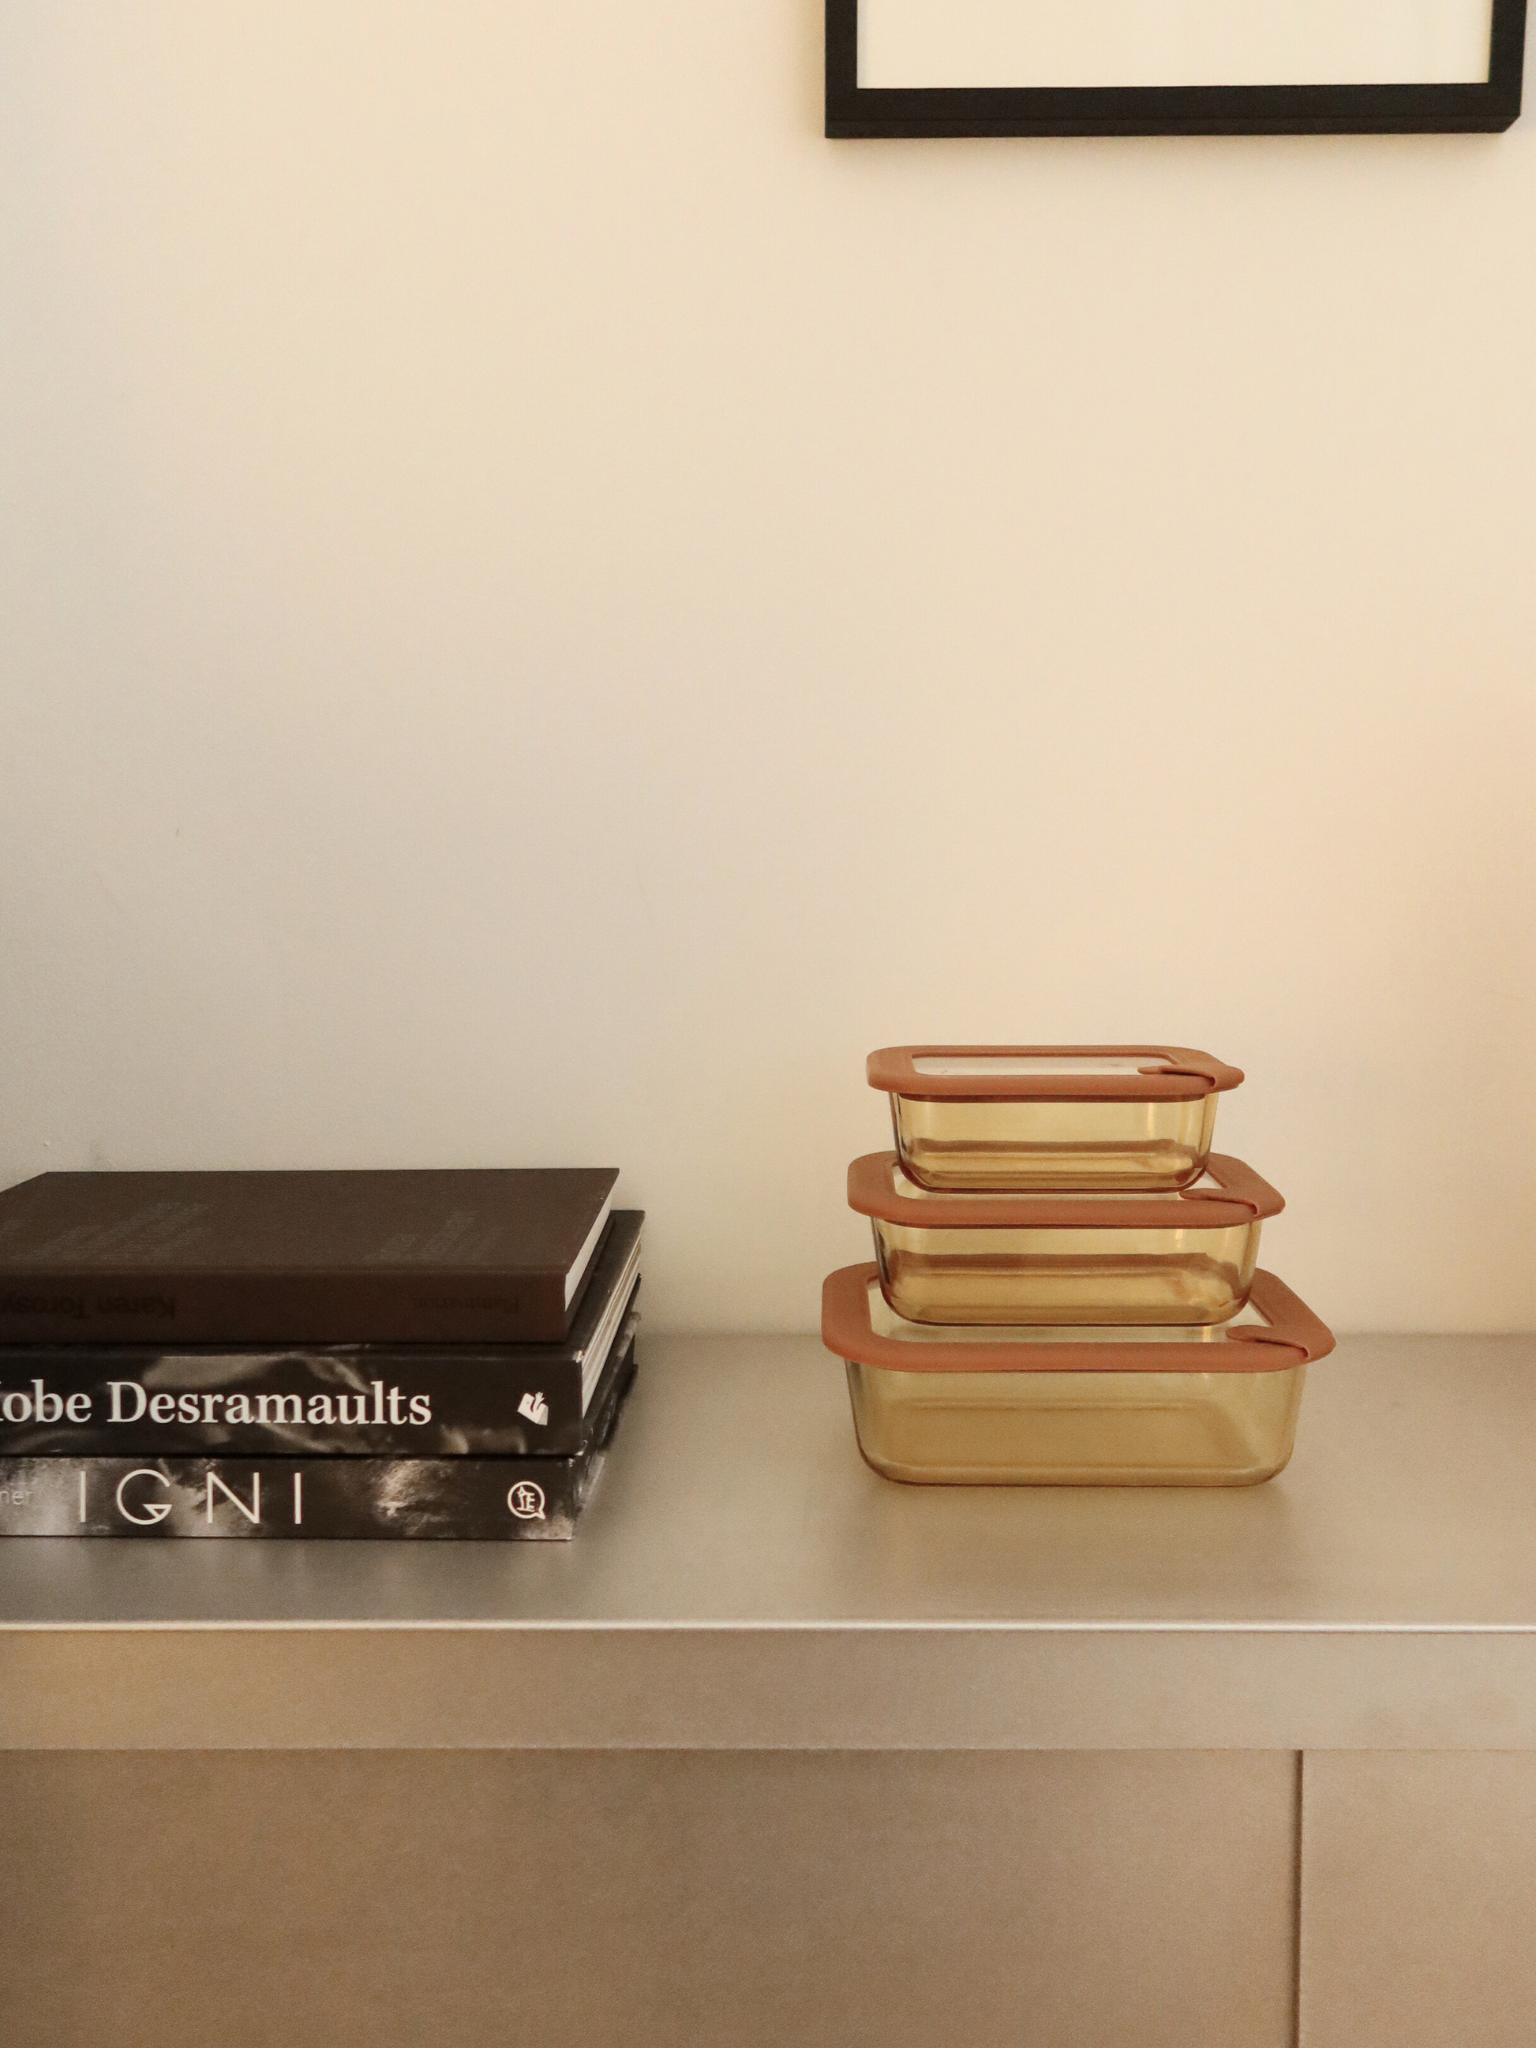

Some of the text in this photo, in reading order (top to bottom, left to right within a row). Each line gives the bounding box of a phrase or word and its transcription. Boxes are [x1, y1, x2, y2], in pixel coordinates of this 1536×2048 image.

[96, 1296, 176, 1321] Karen
[0, 1378, 432, 1426] obe Desramaults
[79, 1468, 303, 1526] IGNI
